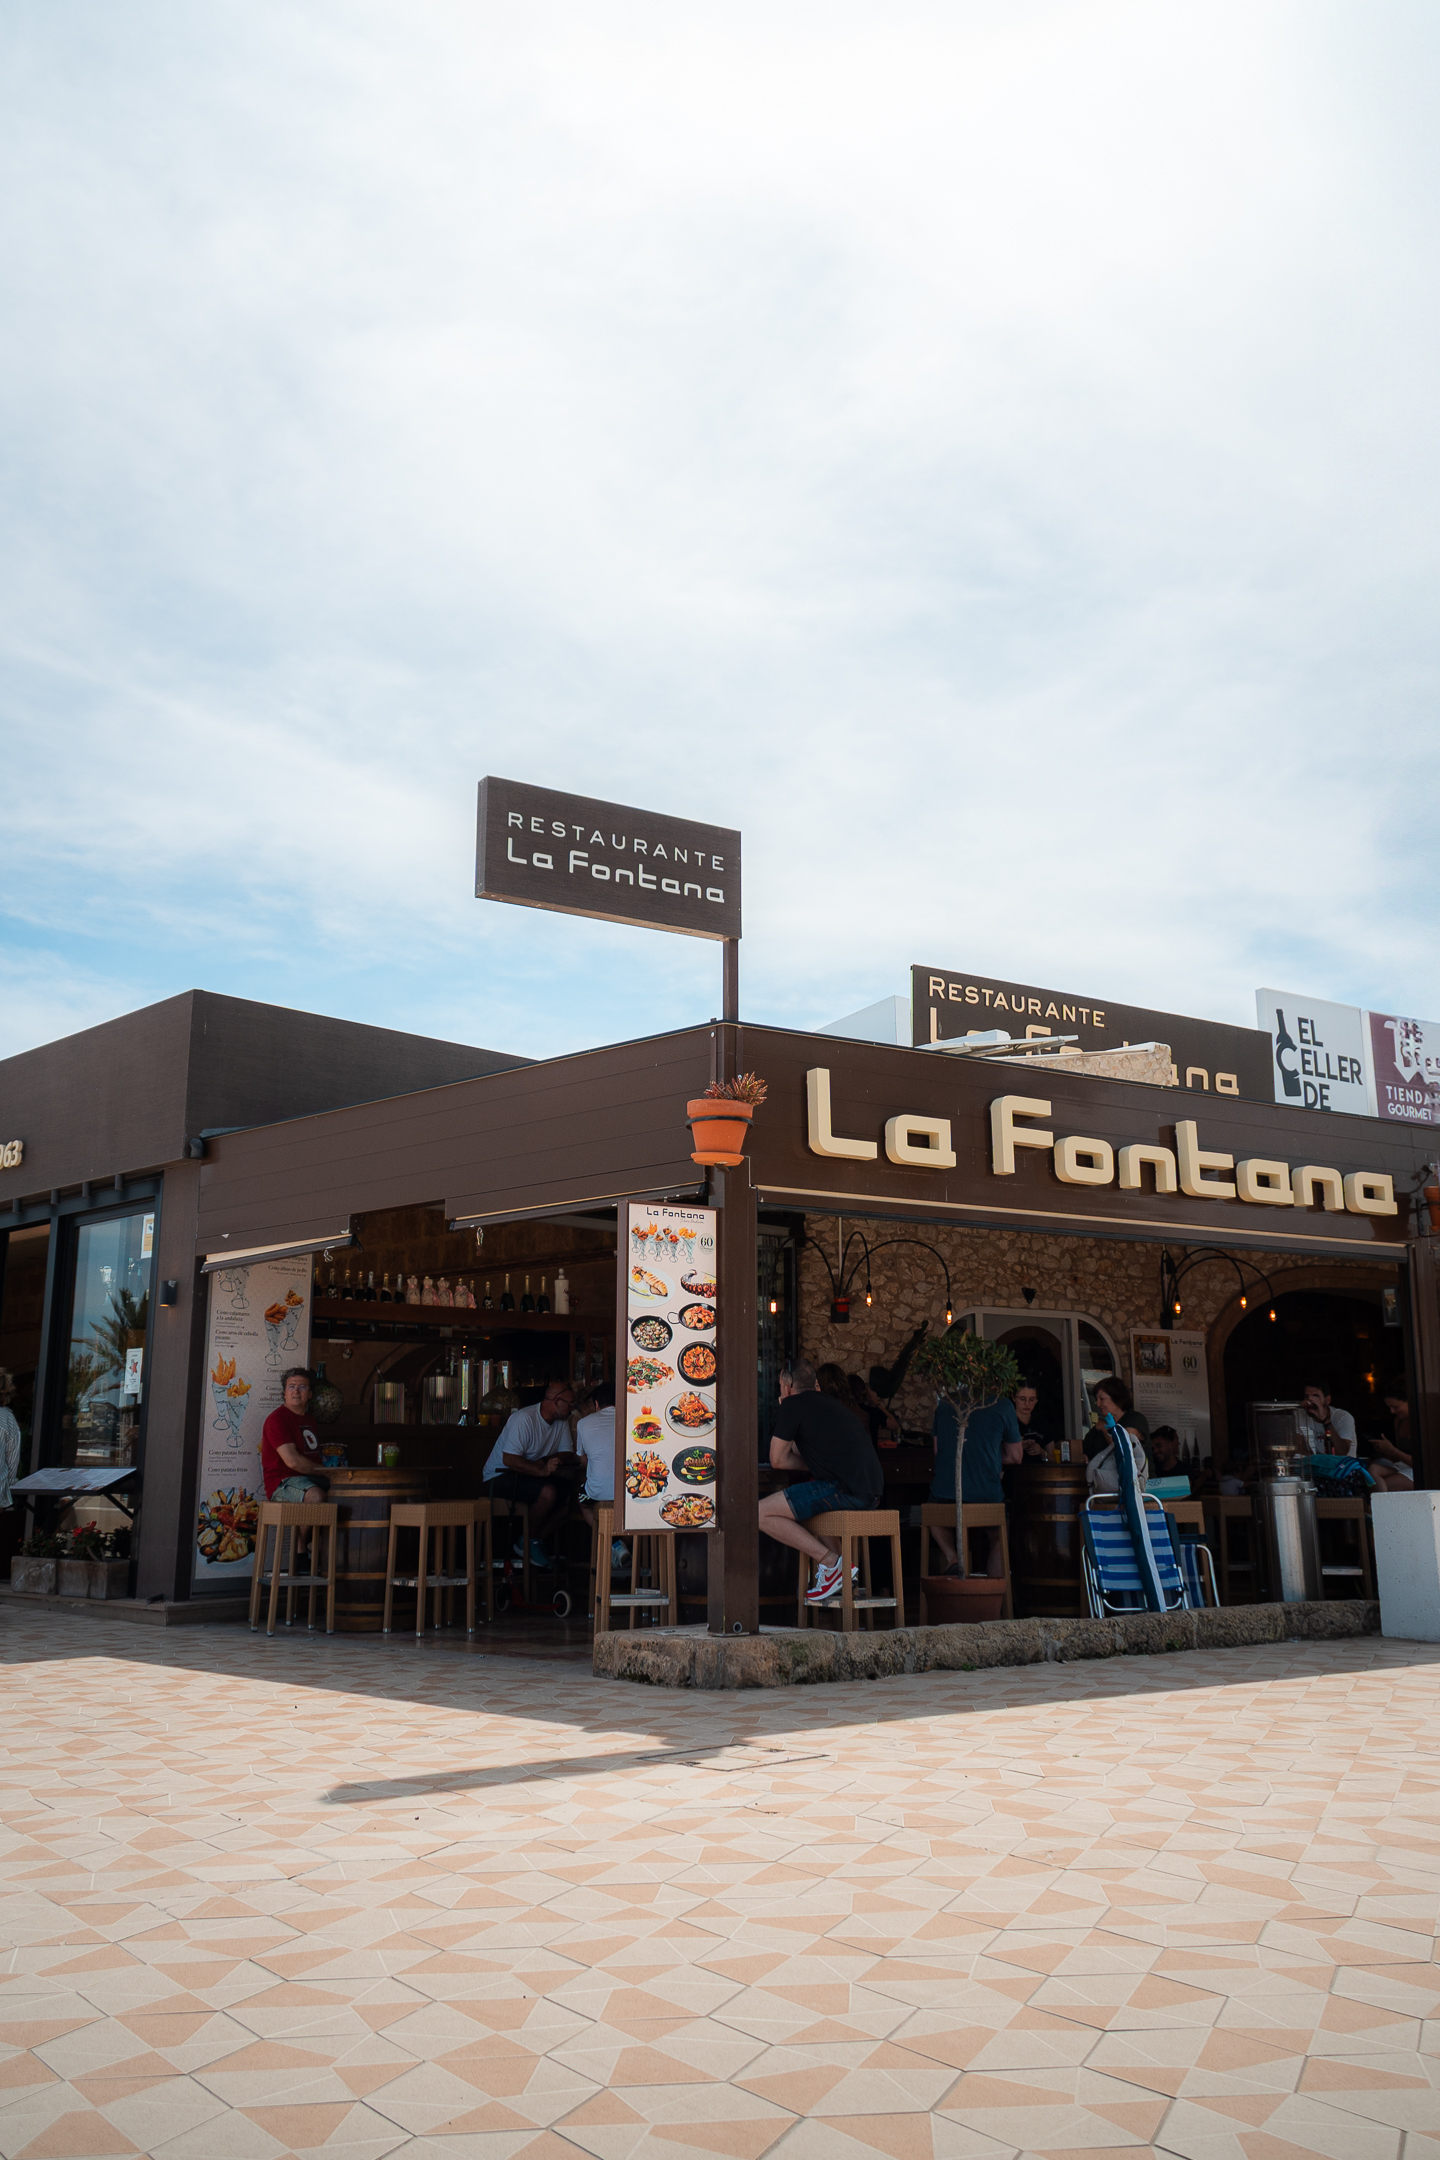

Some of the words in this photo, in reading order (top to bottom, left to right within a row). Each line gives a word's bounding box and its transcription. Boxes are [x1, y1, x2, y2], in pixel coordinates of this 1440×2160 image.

[508, 811, 725, 871] RESTAURANTE
[507, 837, 554, 869] La
[569, 849, 725, 903] Fontana
[928, 975, 1105, 1027] RESTAURANTE
[1297, 1016, 1324, 1047] EL
[1276, 1042, 1363, 1085] CELLER
[1303, 1080, 1332, 1112] DE
[1387, 1102, 1432, 1120] GOURMET
[807, 1067, 956, 1170] La
[990, 1095, 1398, 1215] Fontana
[646, 1206, 659, 1216] La
[662, 1208, 705, 1220] Fontana
[700, 1237, 714, 1247] 60
[1179, 1338, 1203, 1346] Fontana
[1183, 1356, 1197, 1369] 60
